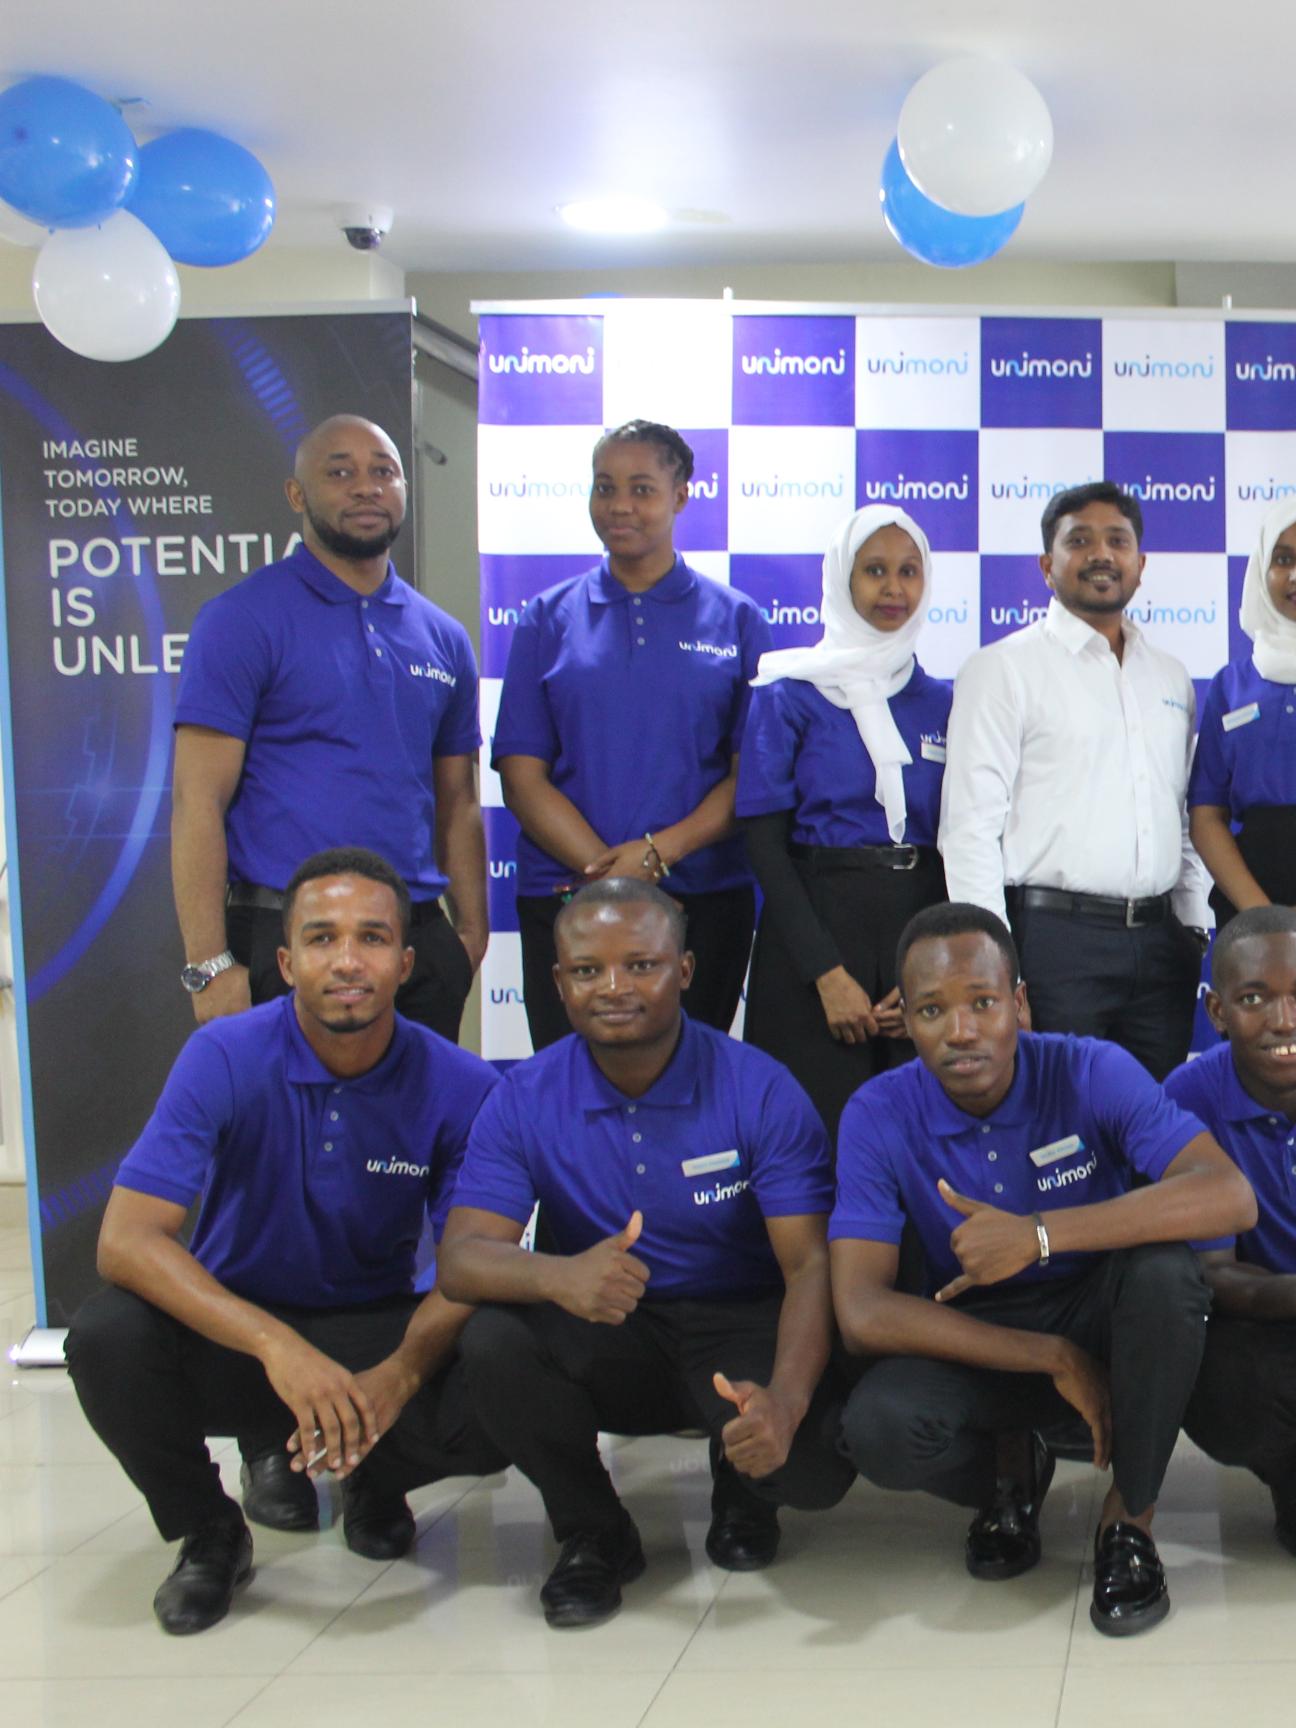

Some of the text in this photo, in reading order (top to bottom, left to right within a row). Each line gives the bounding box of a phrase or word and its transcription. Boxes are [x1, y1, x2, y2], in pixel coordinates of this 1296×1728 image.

[488, 346, 595, 375] unimoni
[741, 348, 846, 376] unimoni
[867, 351, 969, 376] unimoni
[991, 351, 1093, 378] unimoni
[1114, 354, 1215, 379] unimoni
[43, 438, 138, 459] IMAGINE
[44, 466, 189, 489] TOMORROW,
[490, 474, 592, 498] unimon
[741, 473, 844, 499] unimoni
[866, 473, 969, 500] unimoni
[45, 495, 213, 518] TODAY WHERE
[52, 587, 96, 627] IS
